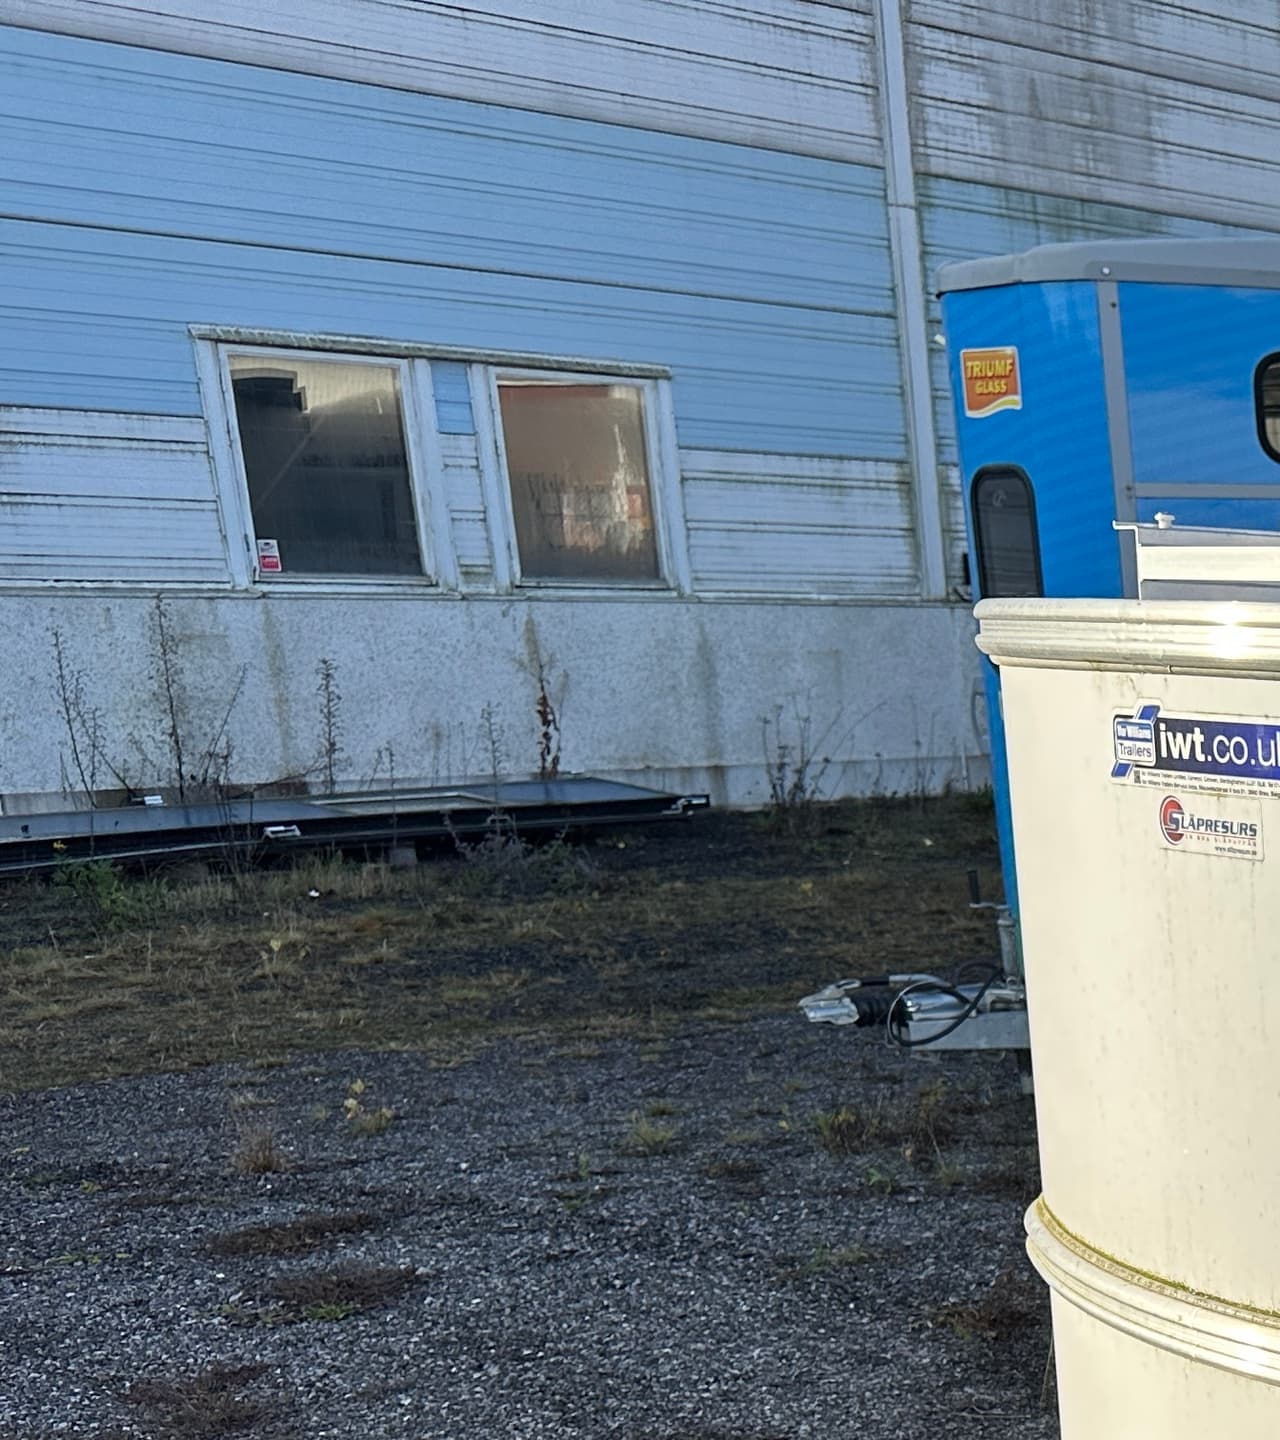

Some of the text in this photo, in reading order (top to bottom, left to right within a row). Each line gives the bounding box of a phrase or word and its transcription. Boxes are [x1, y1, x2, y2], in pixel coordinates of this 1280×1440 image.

[966, 359, 1013, 378] TRIUMF
[975, 380, 1008, 395] GLASS
[1118, 742, 1153, 758] Trailers
[1165, 810, 1258, 838] SLÄPRESURS
